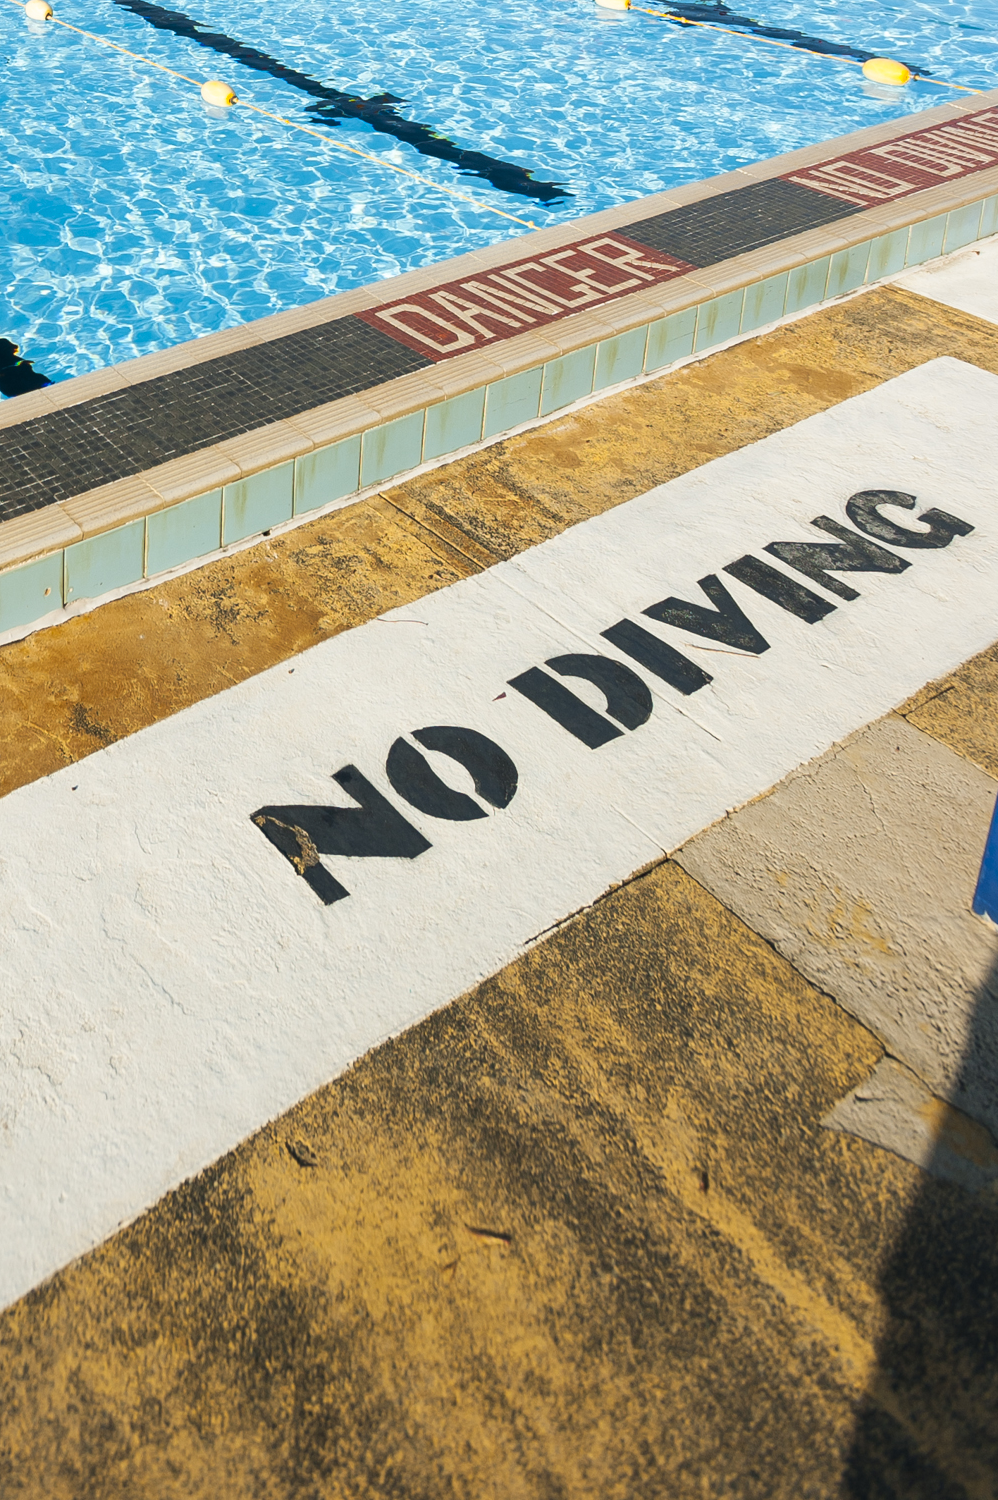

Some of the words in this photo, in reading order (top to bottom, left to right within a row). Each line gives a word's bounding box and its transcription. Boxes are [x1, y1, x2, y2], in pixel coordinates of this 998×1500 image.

[788, 160, 919, 206] NO
[375, 237, 680, 354] DANGER
[250, 725, 519, 905] NO
[506, 489, 976, 750] DIVING
